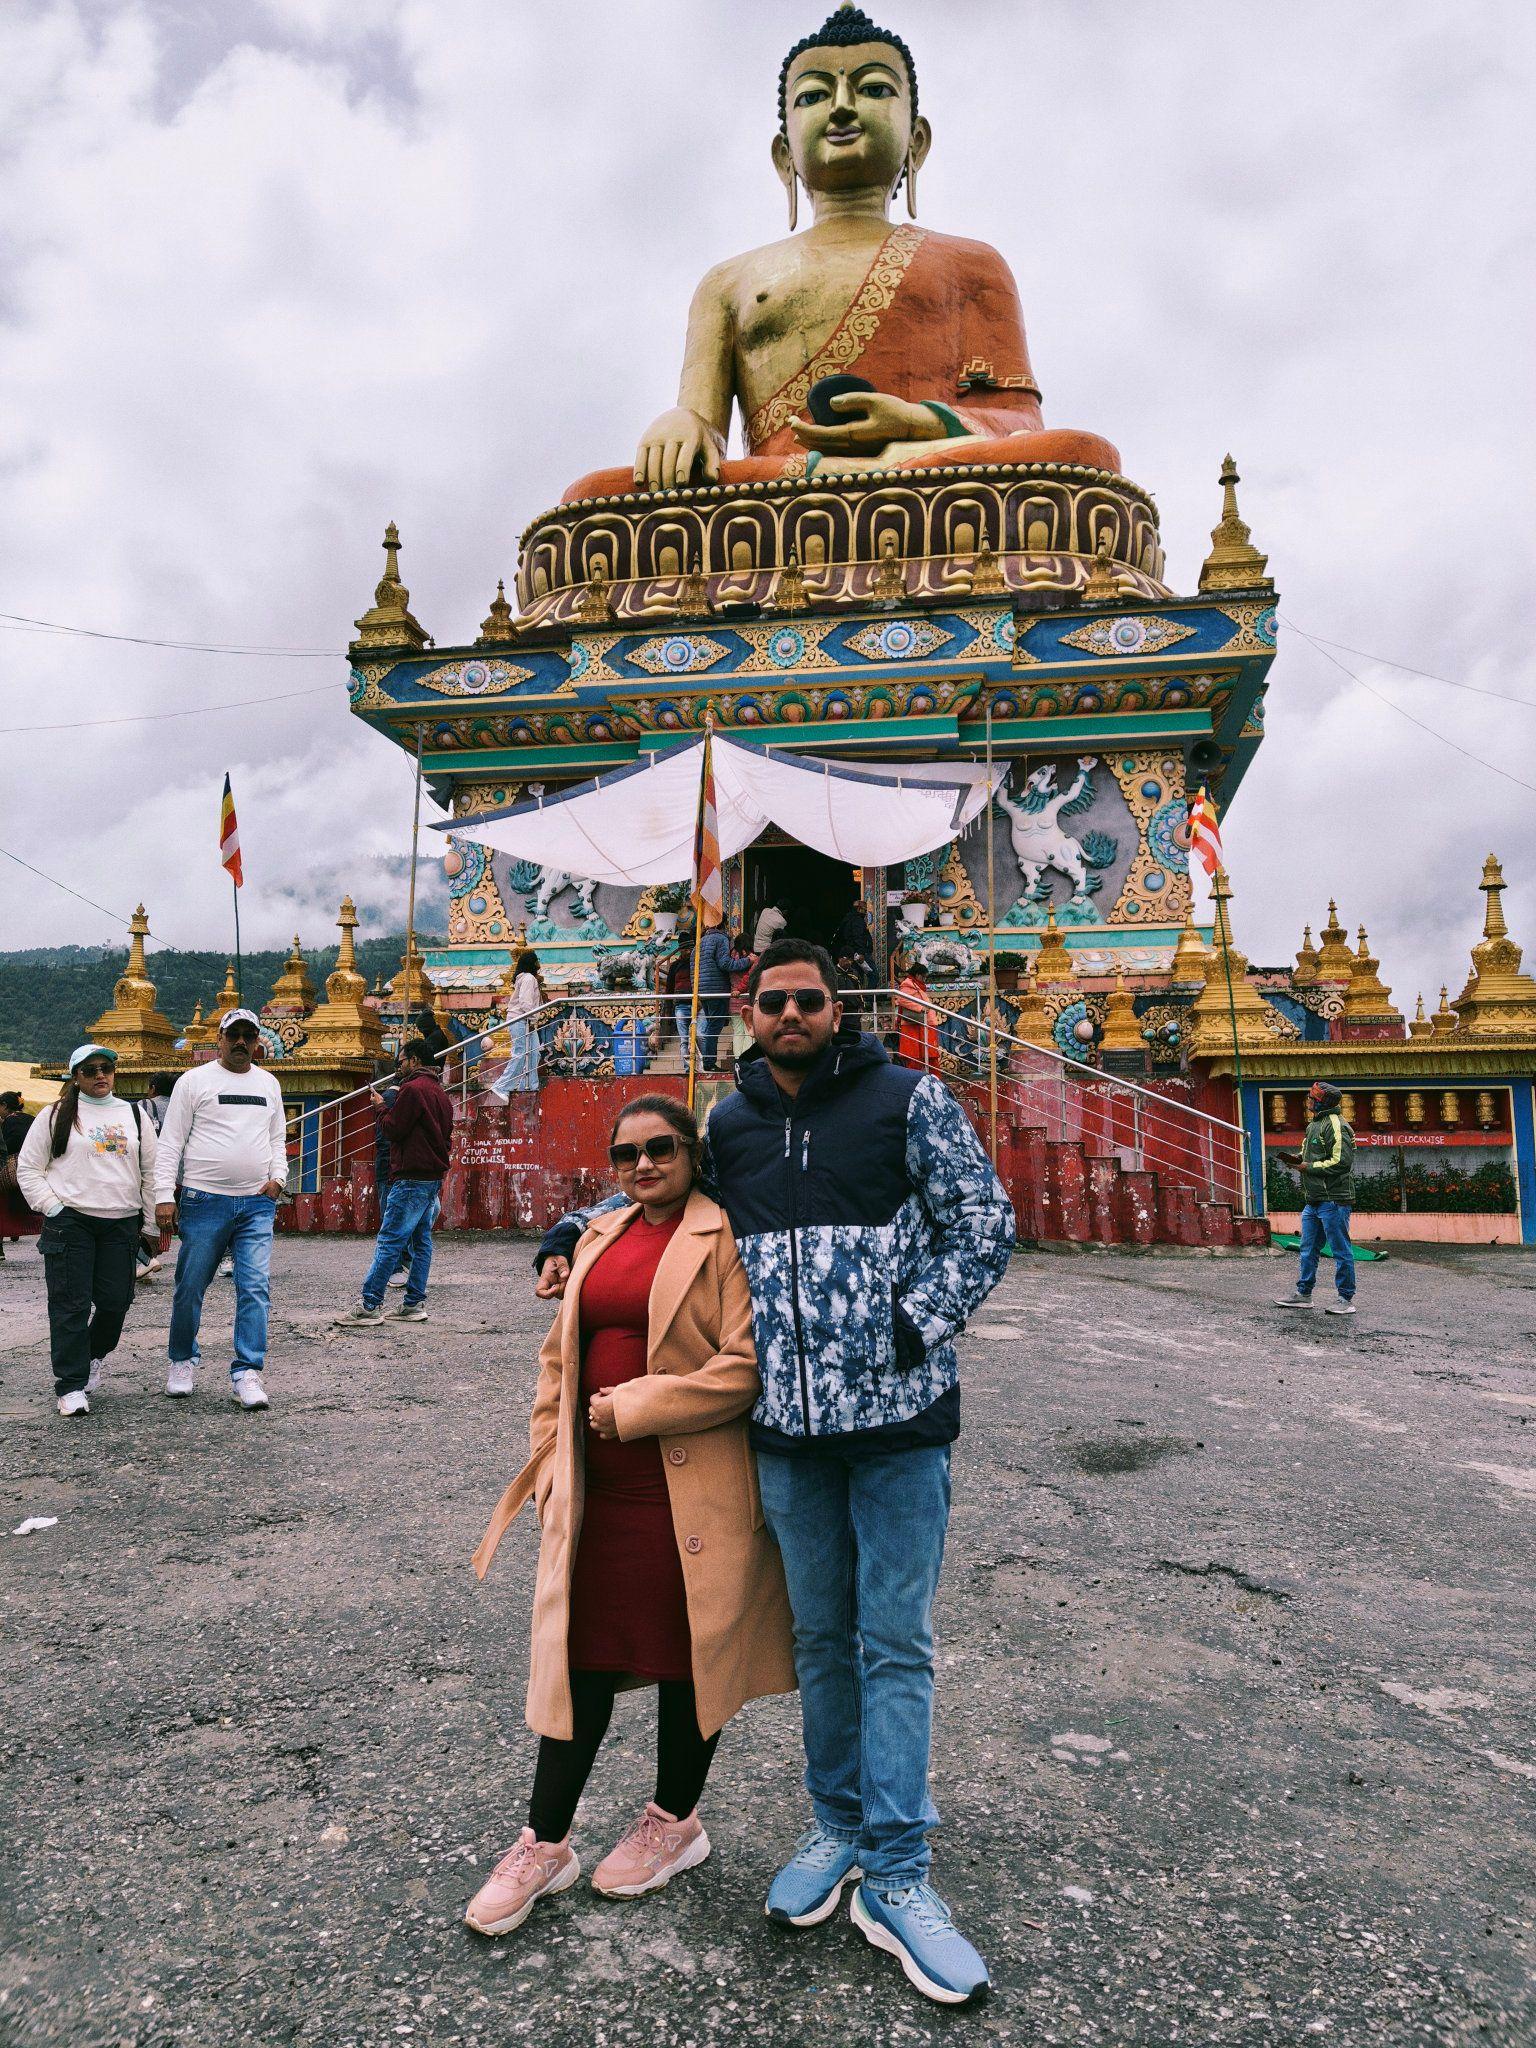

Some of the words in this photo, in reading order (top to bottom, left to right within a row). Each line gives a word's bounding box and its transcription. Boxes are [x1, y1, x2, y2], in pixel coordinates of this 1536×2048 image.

[1370, 1135, 1393, 1145] SPIN
[1398, 1135, 1444, 1144] CLOCKWISE
[492, 1147, 502, 1155] IN
[461, 1155, 505, 1164] CLOCKWISE
